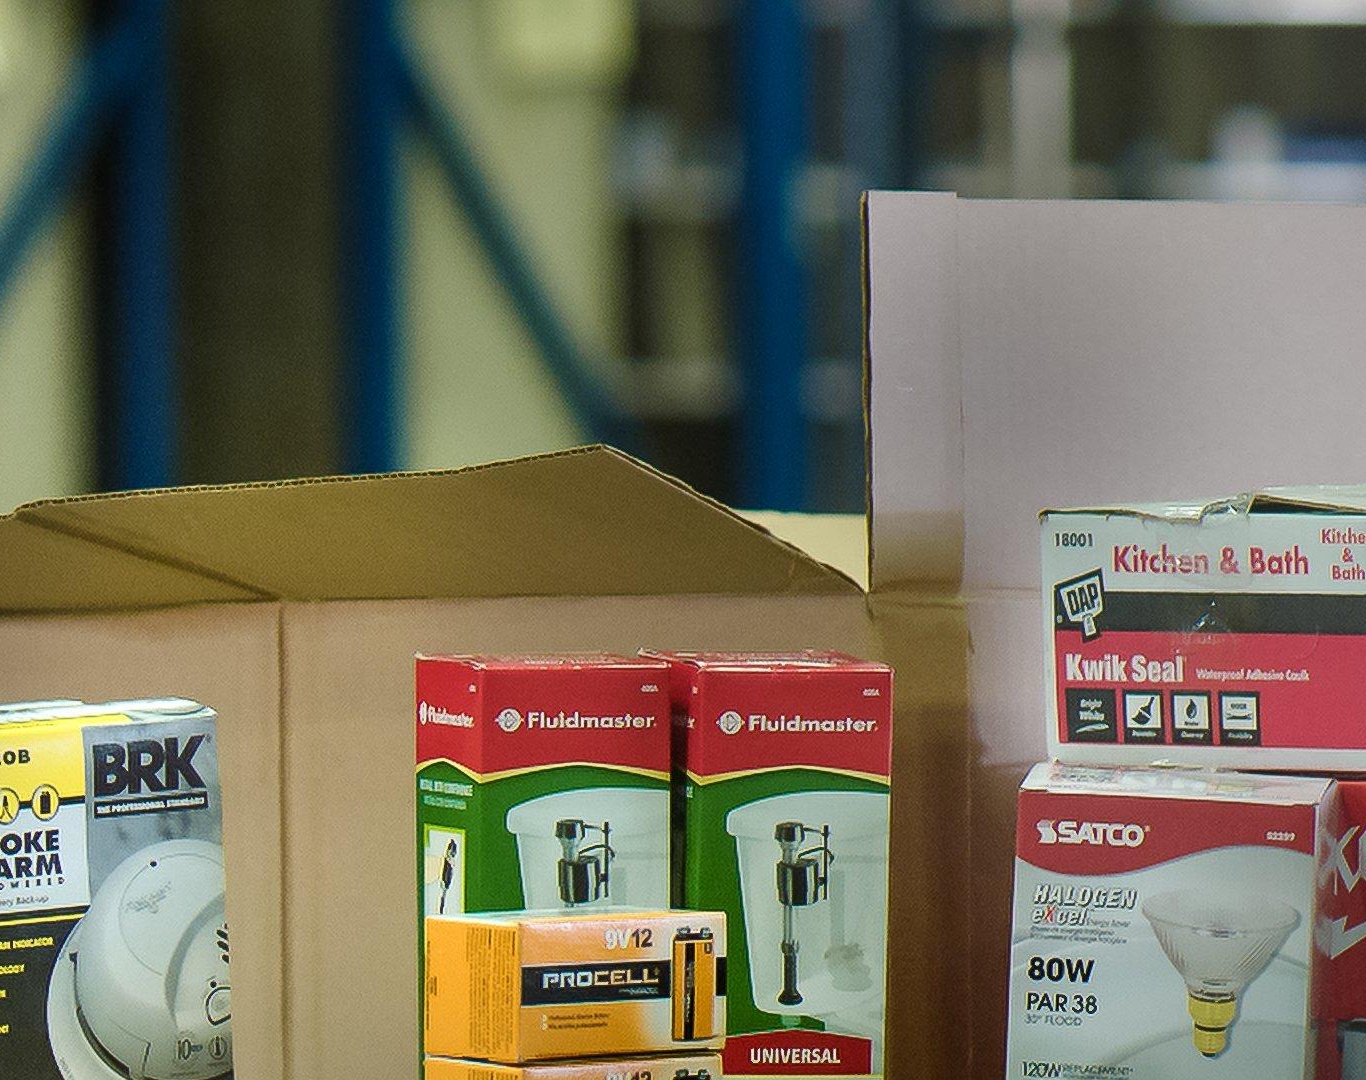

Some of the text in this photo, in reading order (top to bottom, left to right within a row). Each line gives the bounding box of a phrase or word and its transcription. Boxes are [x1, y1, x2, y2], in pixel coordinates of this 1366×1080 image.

[1112, 544, 1210, 574] Kitchen
[1218, 545, 1241, 575] &
[1249, 544, 1310, 575] Bath
[1341, 549, 1354, 562] &
[1331, 563, 1366, 581] Bath
[1066, 583, 1100, 615] DAP
[1065, 652, 1184, 683] Kwik Seal
[527, 710, 655, 730] Fluidmaster
[747, 714, 877, 732] Fluidmaster
[92, 734, 208, 797] BRK
[1058, 820, 1145, 847] SATCO
[1033, 884, 1138, 911] HALOGEN
[542, 968, 659, 989] PROCELL
[1027, 956, 1095, 984] 80W
[1026, 992, 1098, 1015] PAR 38
[750, 1048, 841, 1064] UNIVERSAL
